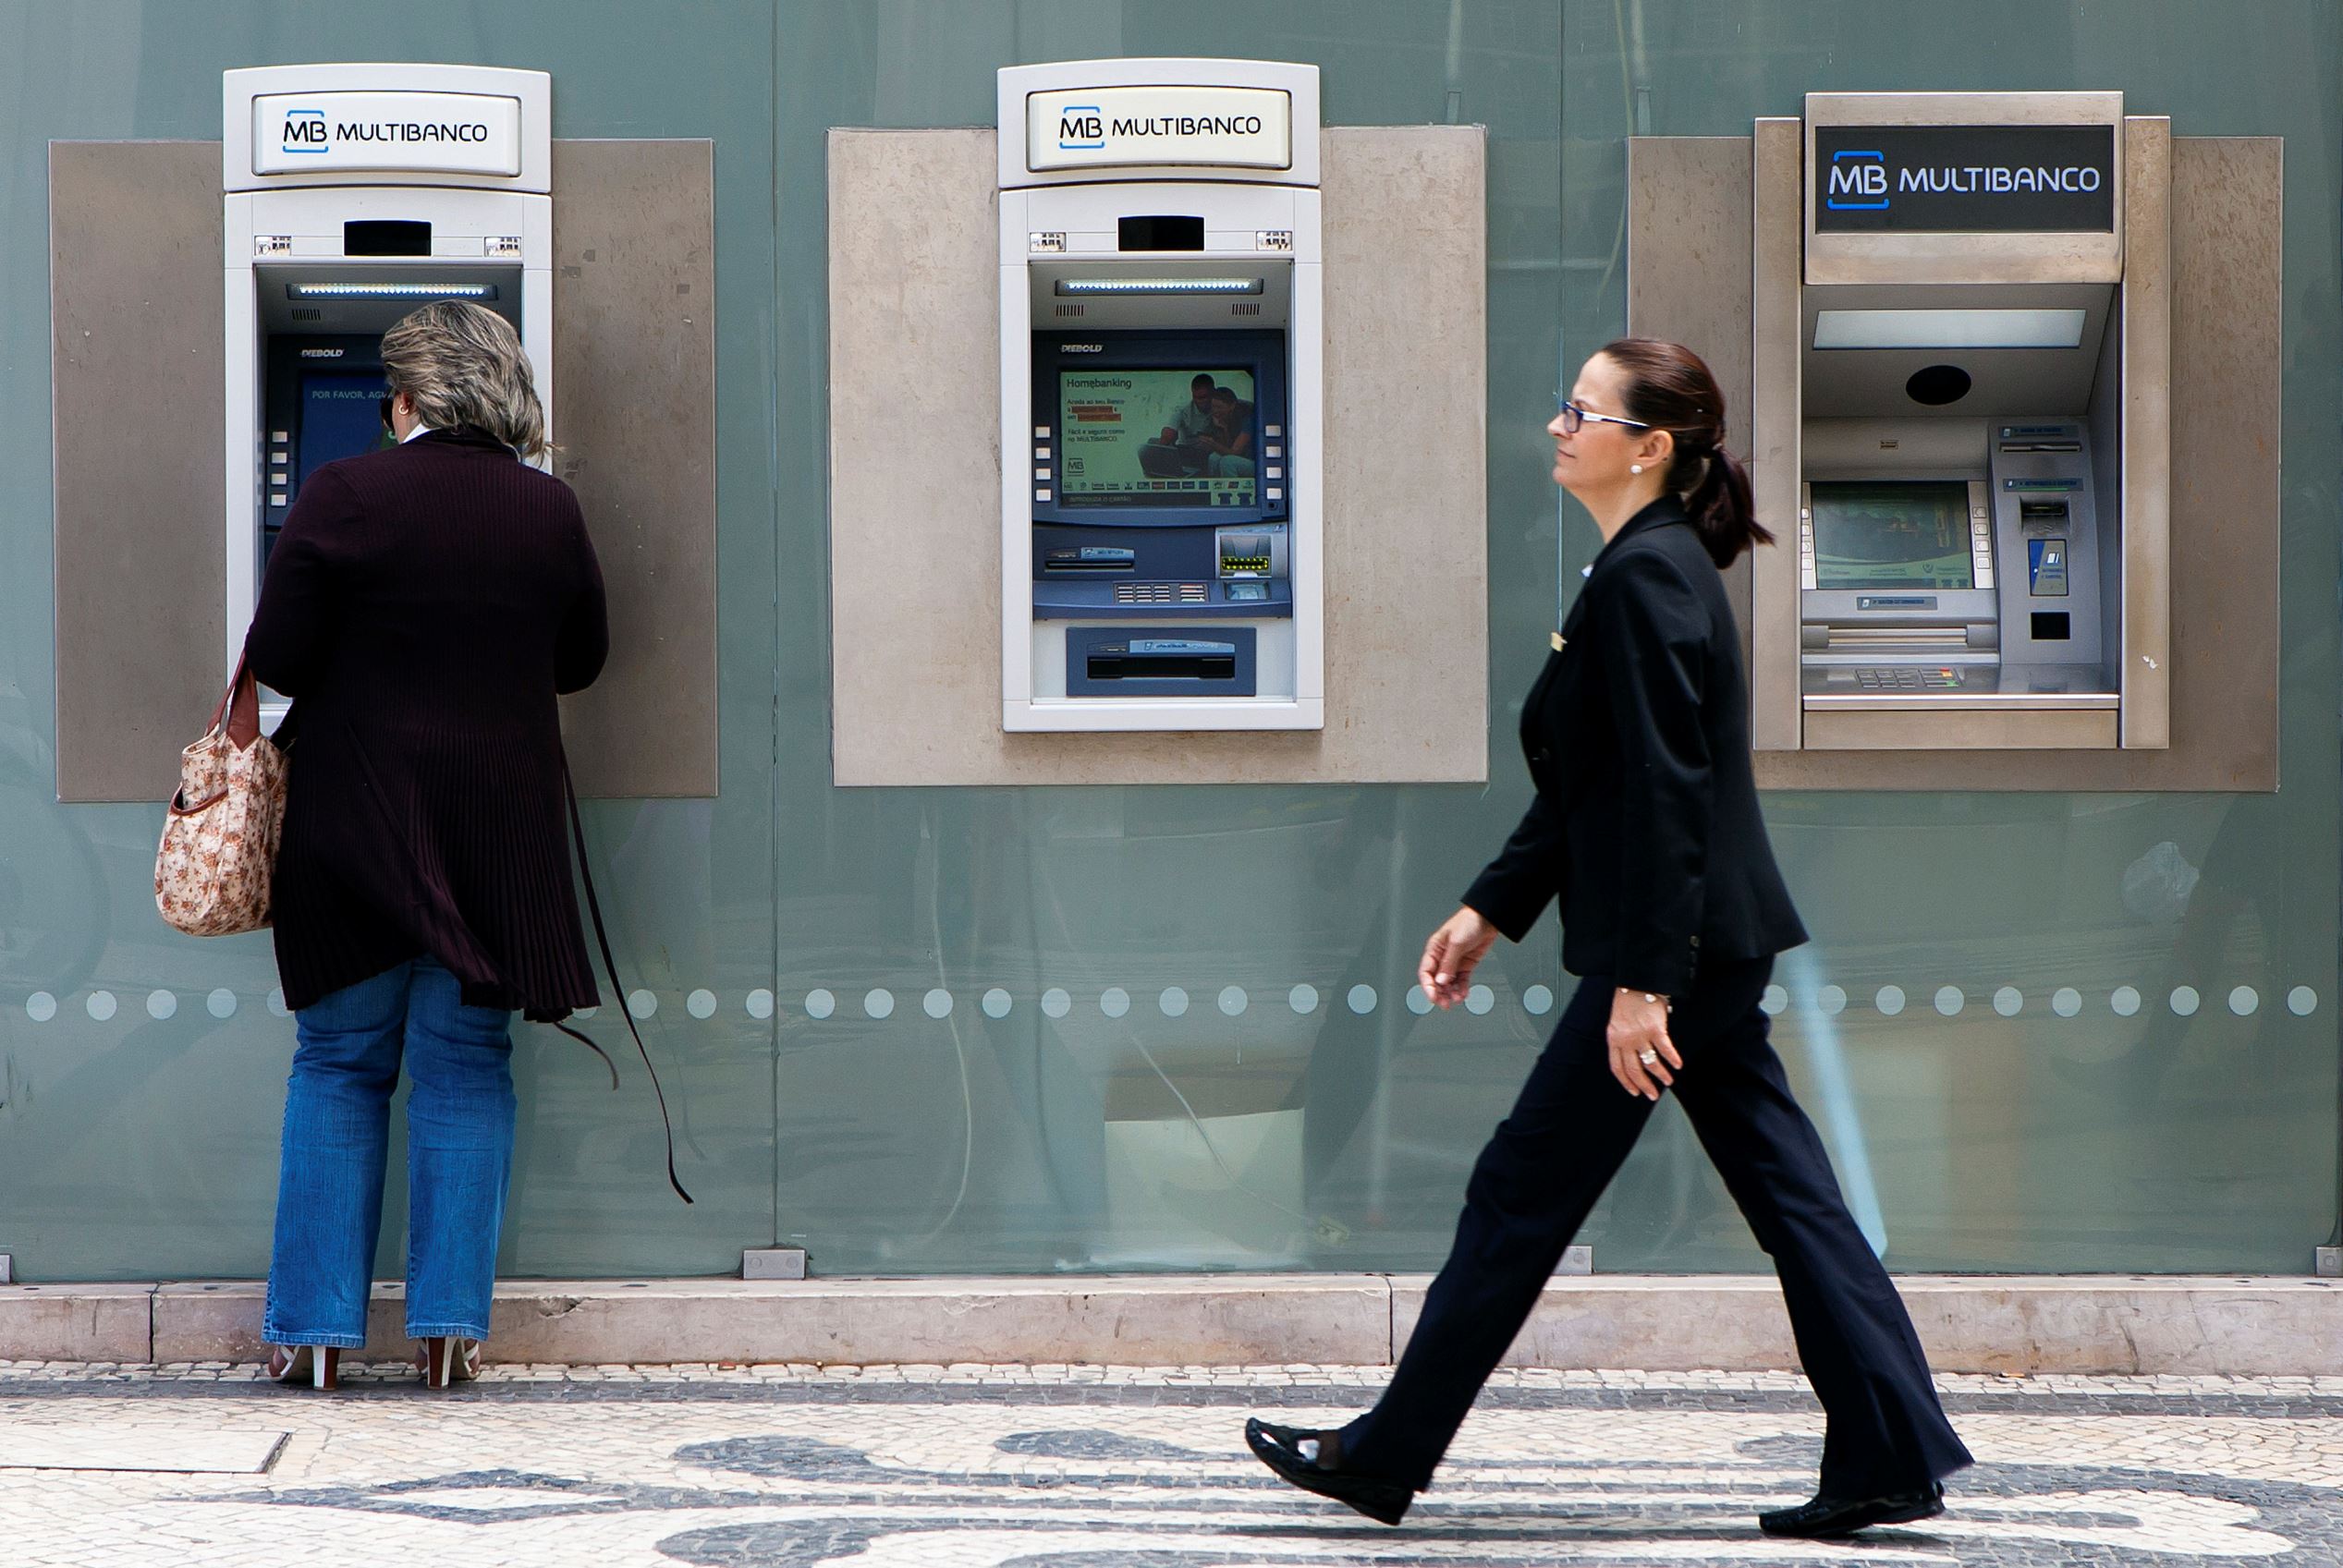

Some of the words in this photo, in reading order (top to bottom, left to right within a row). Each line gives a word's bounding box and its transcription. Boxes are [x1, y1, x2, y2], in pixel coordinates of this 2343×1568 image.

[284, 121, 328, 142] MB
[336, 123, 488, 142] MULTIBANCO
[1059, 116, 1104, 139] MB
[1112, 116, 1262, 137] MULTIBANCO
[1828, 164, 1888, 195] MB
[1898, 167, 2101, 192] MULTIBANCO
[301, 349, 344, 358] DIEBOLD
[1067, 378, 1131, 390] Homebanking
[311, 390, 330, 399] POR
[333, 390, 366, 400] FAVOR,
